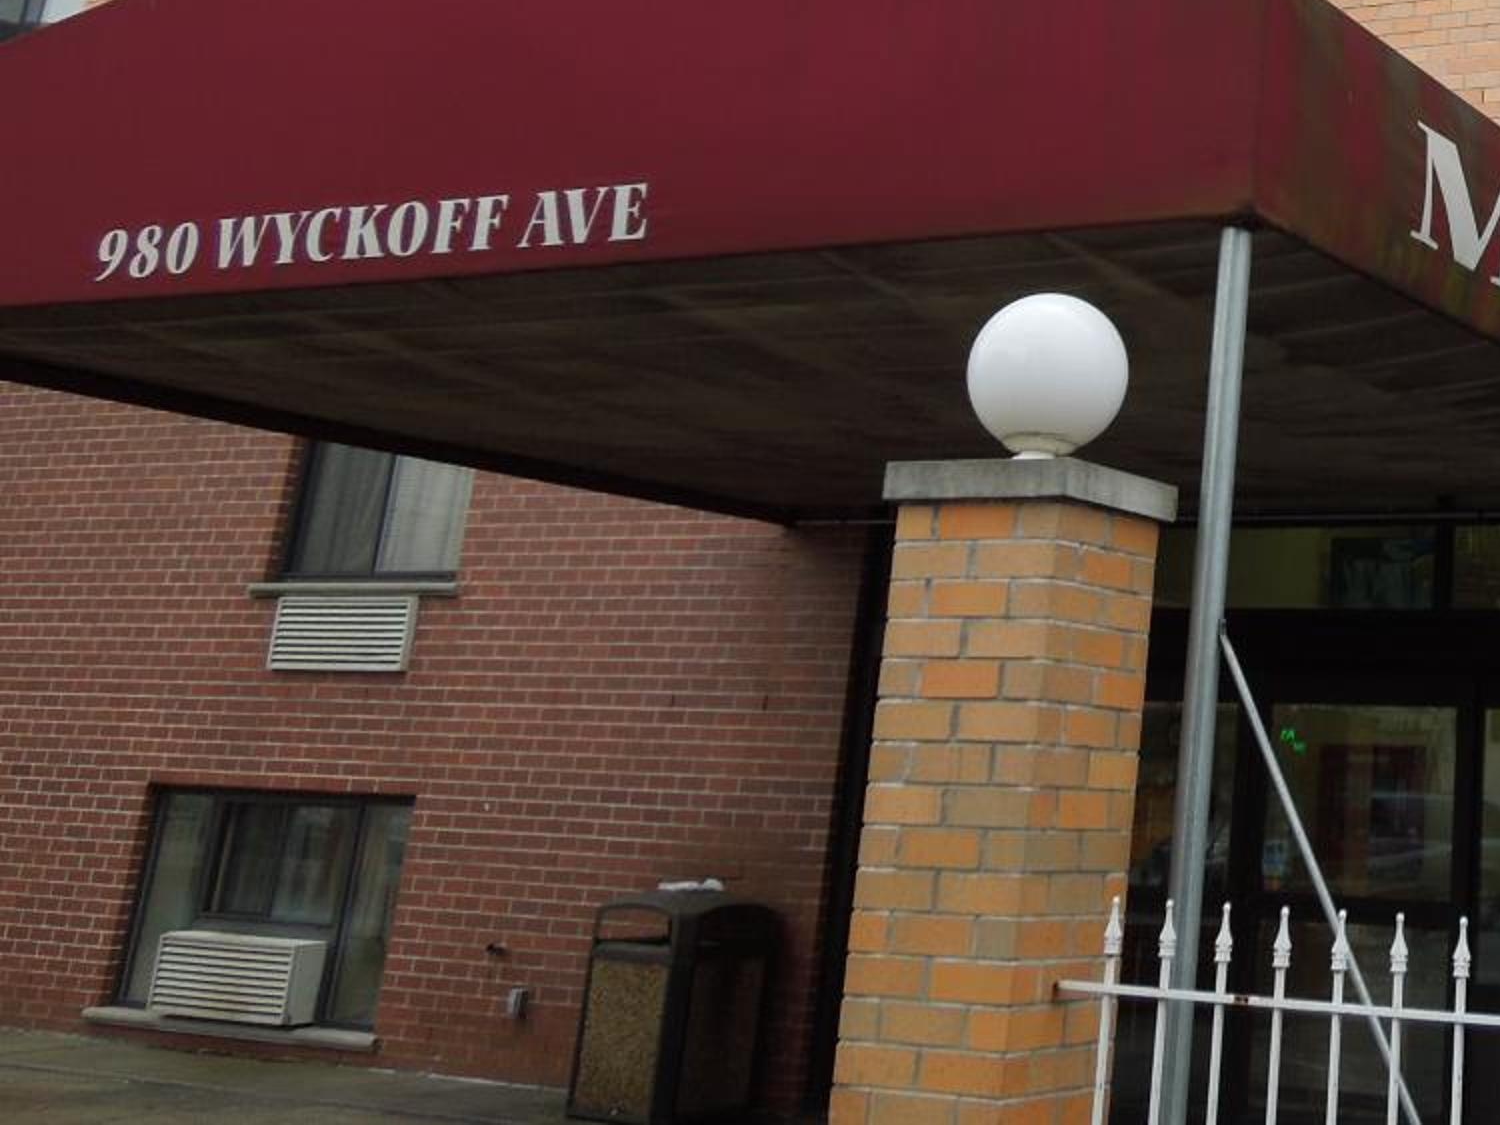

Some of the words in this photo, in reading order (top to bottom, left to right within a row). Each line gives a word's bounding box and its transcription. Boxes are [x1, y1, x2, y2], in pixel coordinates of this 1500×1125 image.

[96, 222, 198, 281] 980
[217, 194, 509, 268] WYCKOFF
[517, 183, 648, 247] AVE
